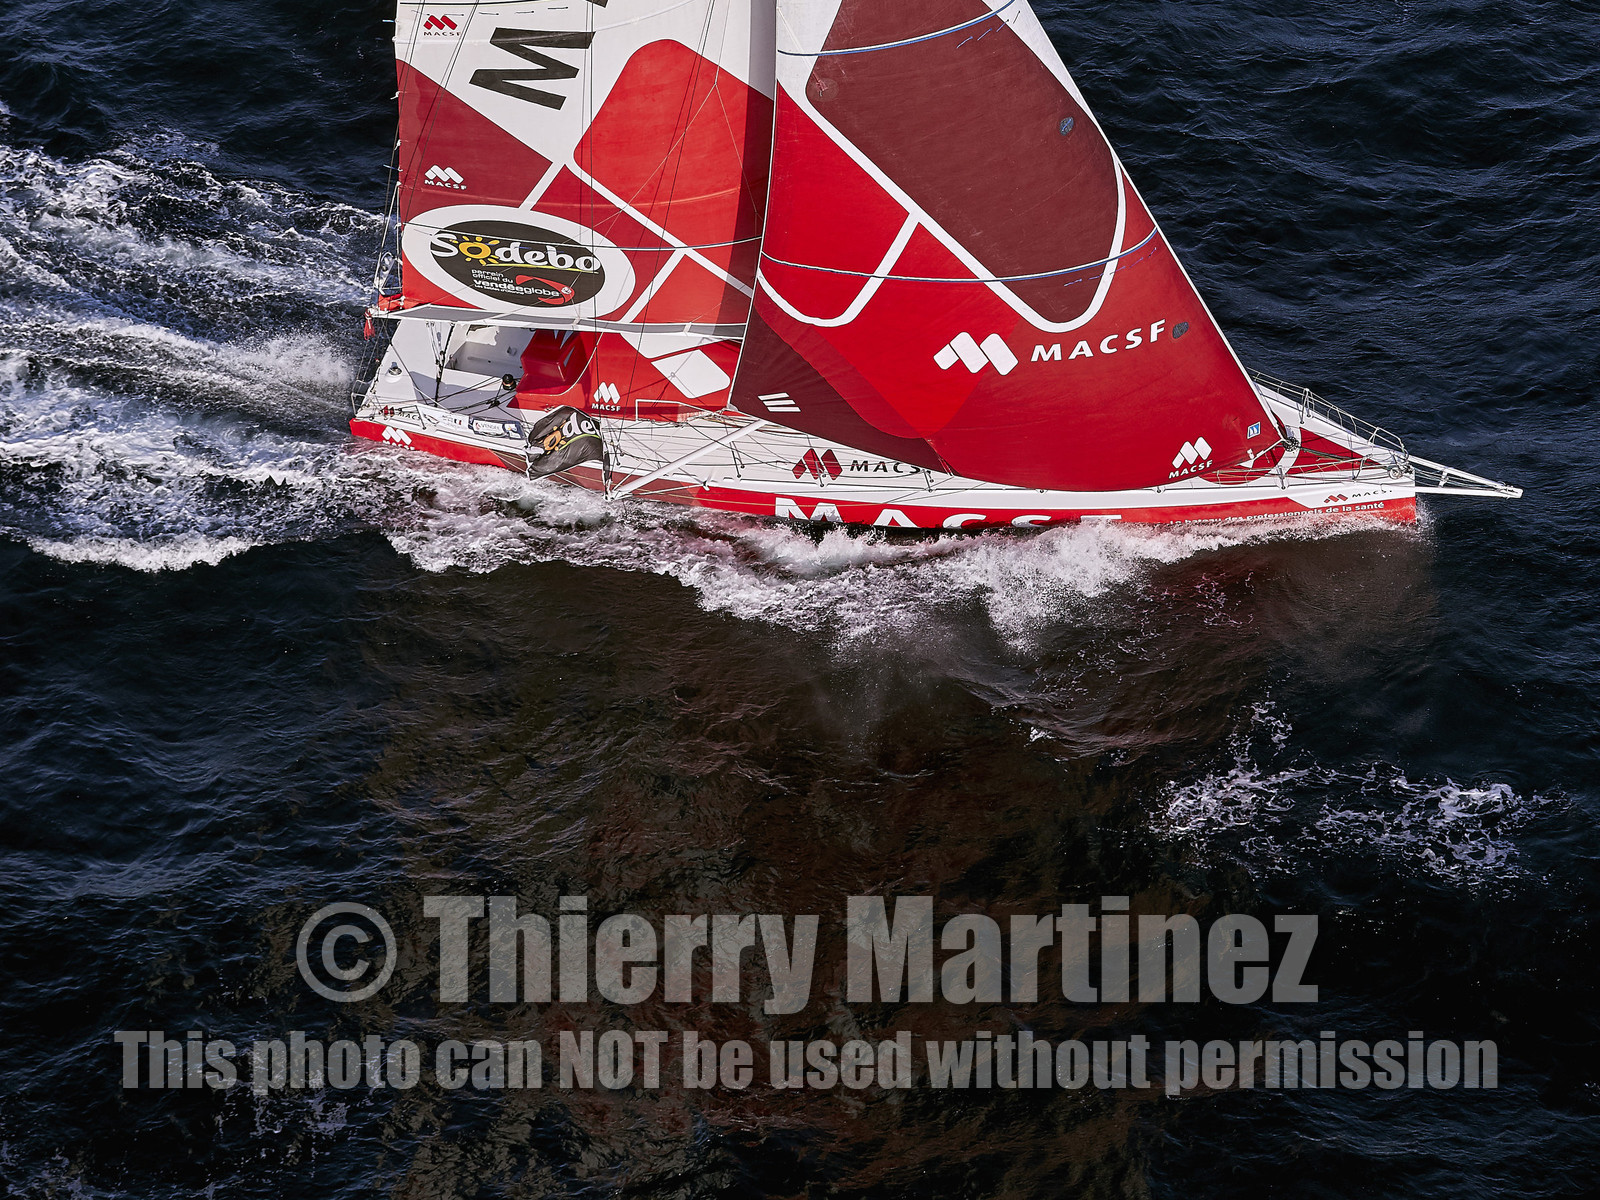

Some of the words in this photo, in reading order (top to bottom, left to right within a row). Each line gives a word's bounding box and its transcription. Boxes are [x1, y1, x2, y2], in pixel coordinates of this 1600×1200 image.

[424, 179, 467, 190] MACSF
[430, 233, 601, 272] Sodebo
[1030, 318, 1166, 362] MACSF
[591, 403, 621, 412] MACSF
[849, 459, 932, 475] MACS
[1168, 460, 1213, 479] MACSF
[1325, 506, 1339, 514] de
[1355, 502, 1385, 511] santé
